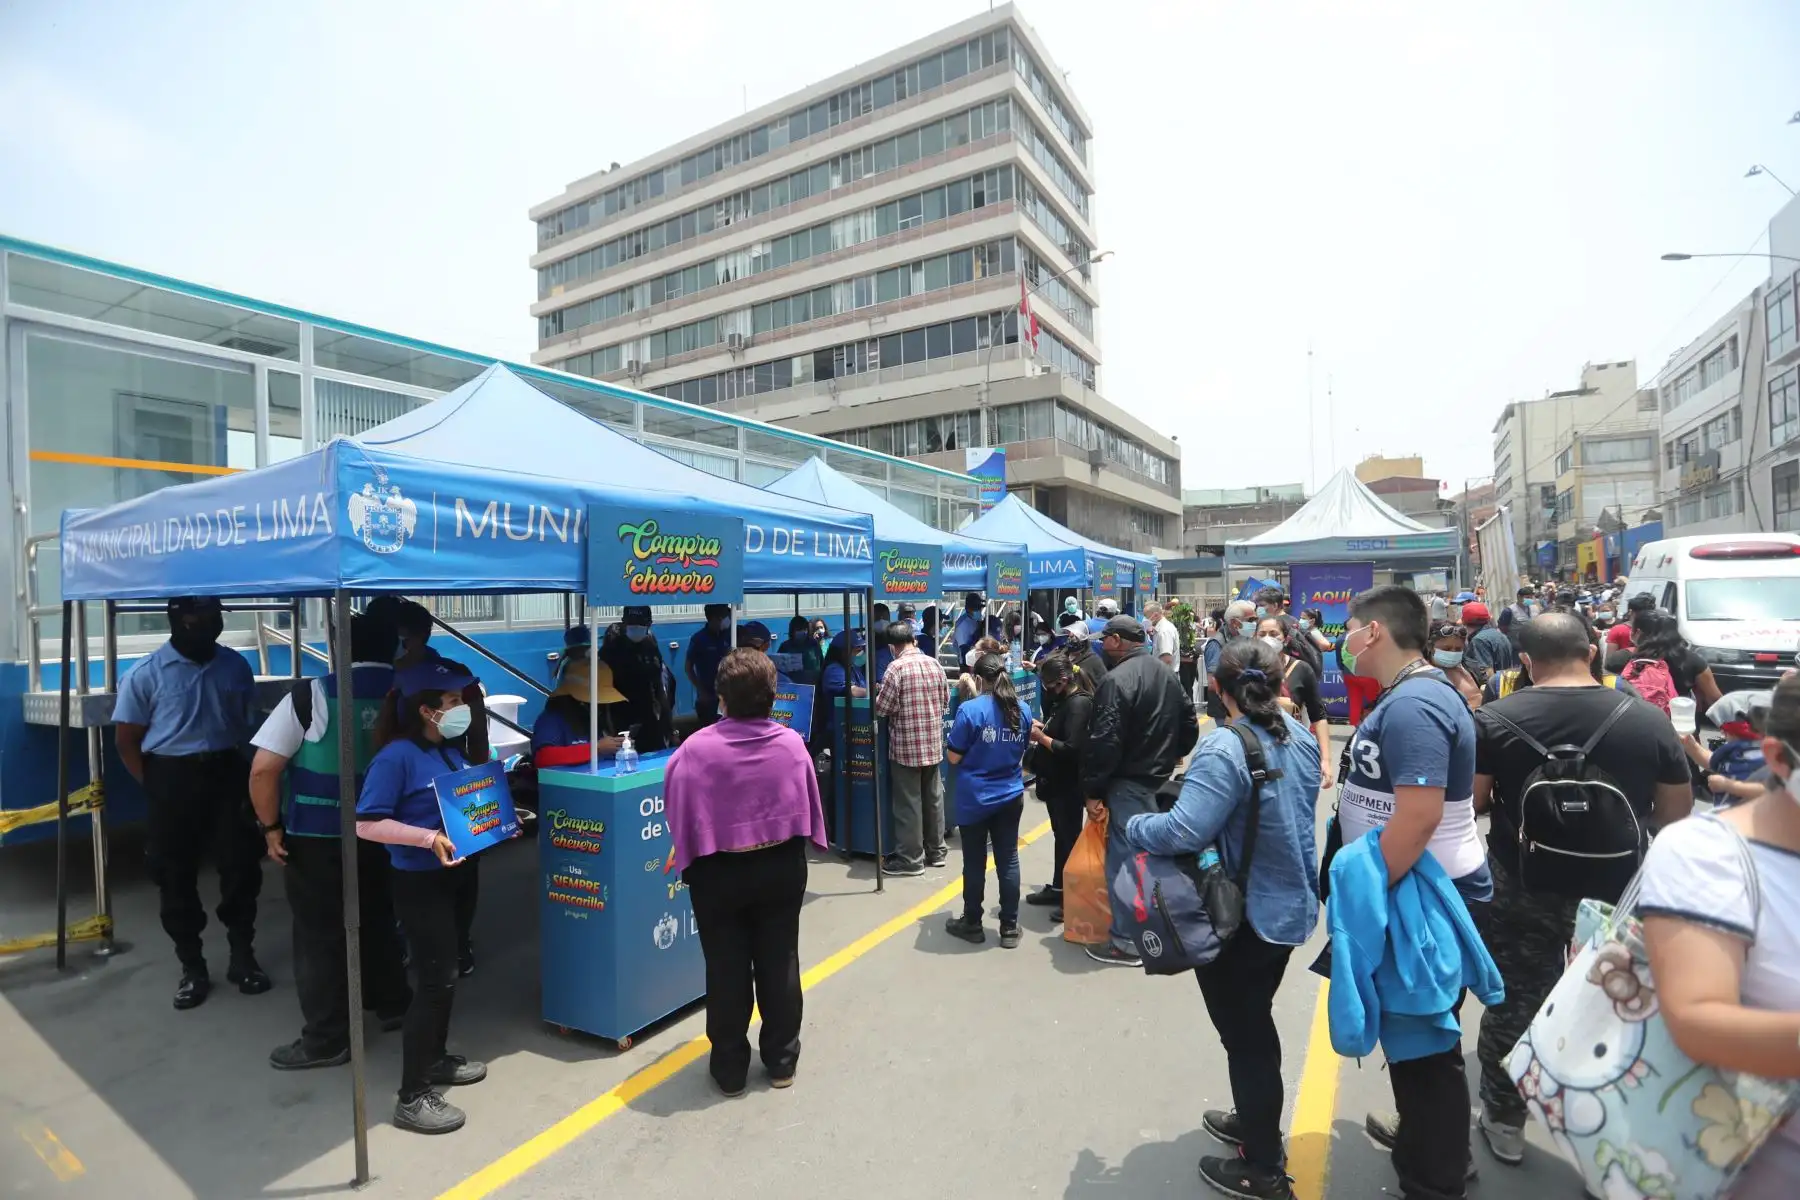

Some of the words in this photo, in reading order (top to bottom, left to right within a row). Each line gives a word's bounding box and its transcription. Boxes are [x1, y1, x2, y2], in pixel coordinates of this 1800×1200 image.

[81, 512, 211, 565] MUNICIPALIDAD
[216, 505, 246, 548] DE
[256, 491, 332, 542] LIMA
[455, 497, 589, 544] MUNI
[772, 526, 805, 556] DE
[814, 531, 872, 560] LIMA
[618, 518, 722, 562] Compra
[879, 548, 931, 575] Compra
[1029, 559, 1077, 575] LIMA
[629, 567, 716, 594] chévere
[884, 575, 929, 593] chévere
[463, 800, 499, 821] Compra
[640, 796, 665, 816] Ob
[1343, 788, 1395, 813] EQUIPMEN
[547, 808, 606, 834] Compra
[641, 821, 662, 841] de
[552, 834, 602, 856] chévere
[569, 865, 582, 875] Usa
[552, 874, 601, 895] SIEMPRE
[548, 890, 605, 912] mascarilla
